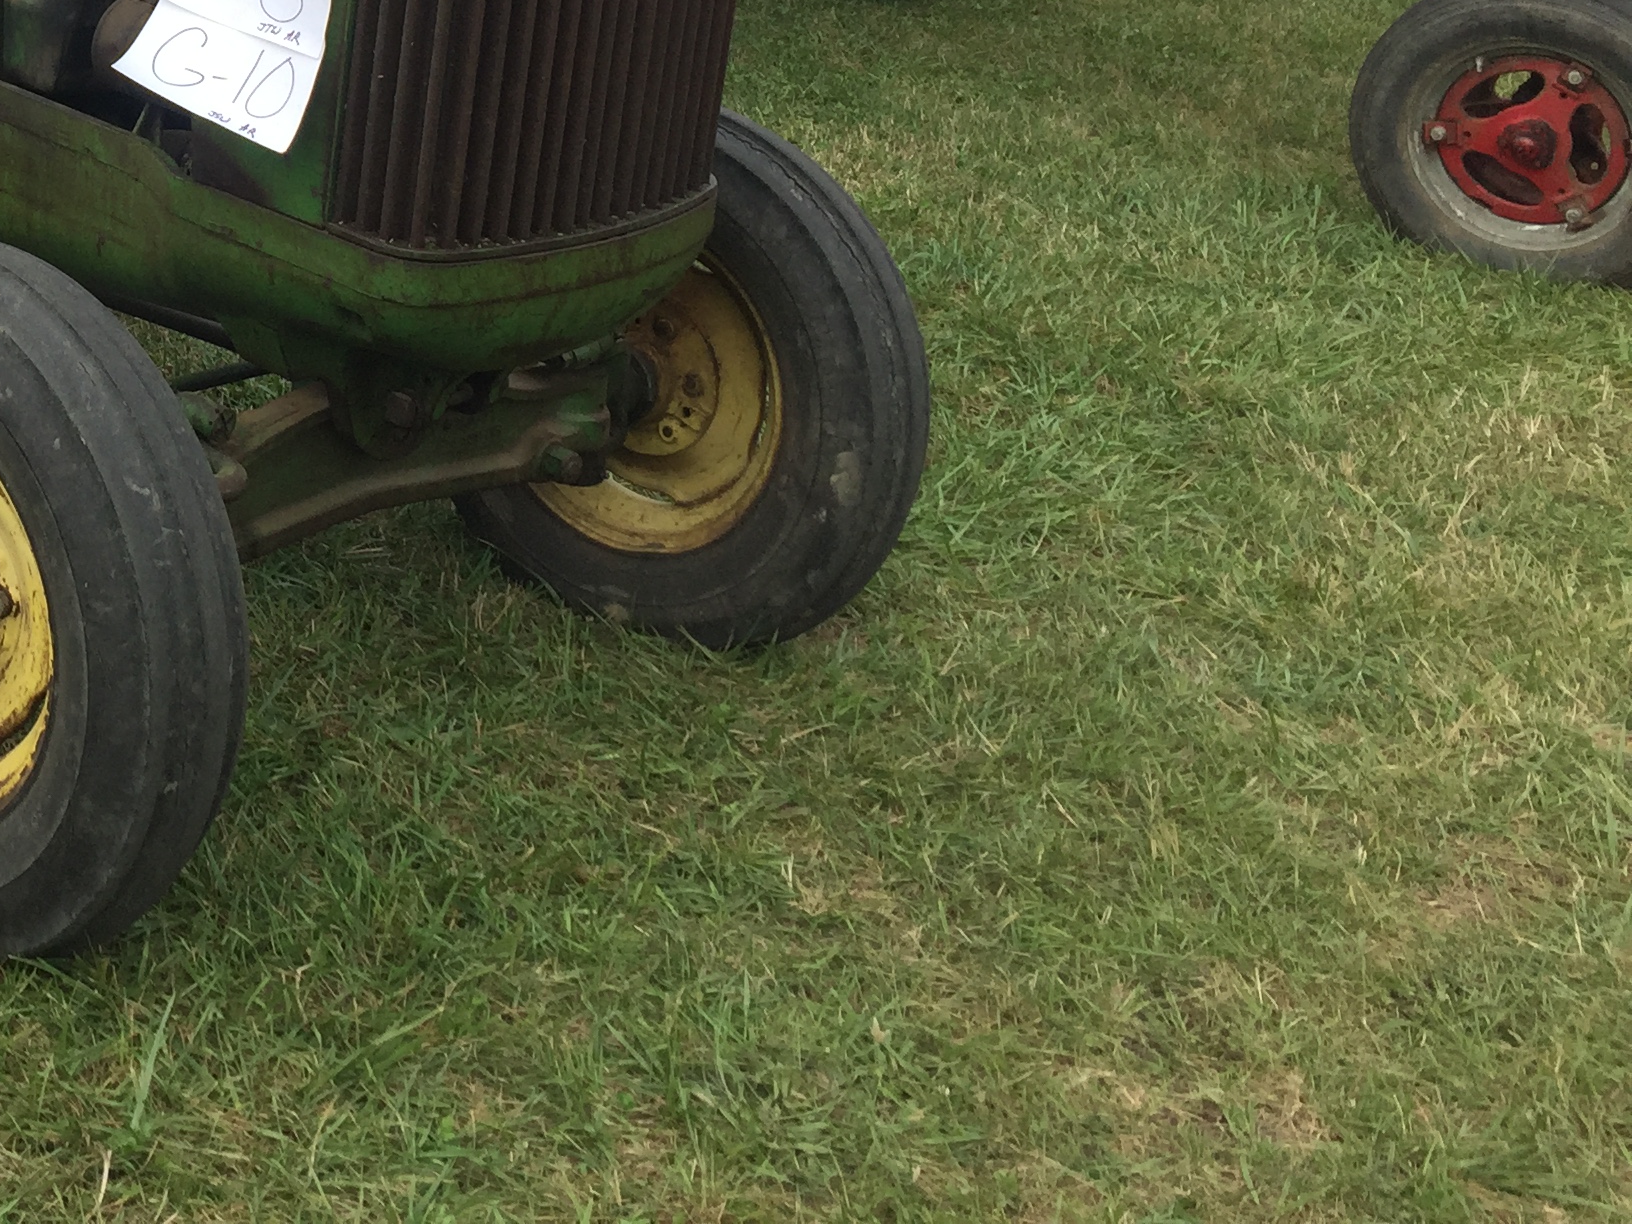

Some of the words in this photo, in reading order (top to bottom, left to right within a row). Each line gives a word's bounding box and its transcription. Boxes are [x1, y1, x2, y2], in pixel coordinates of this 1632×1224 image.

[283, 30, 301, 46] AR
[152, 27, 295, 119] G-10
[238, 124, 256, 139] AR
